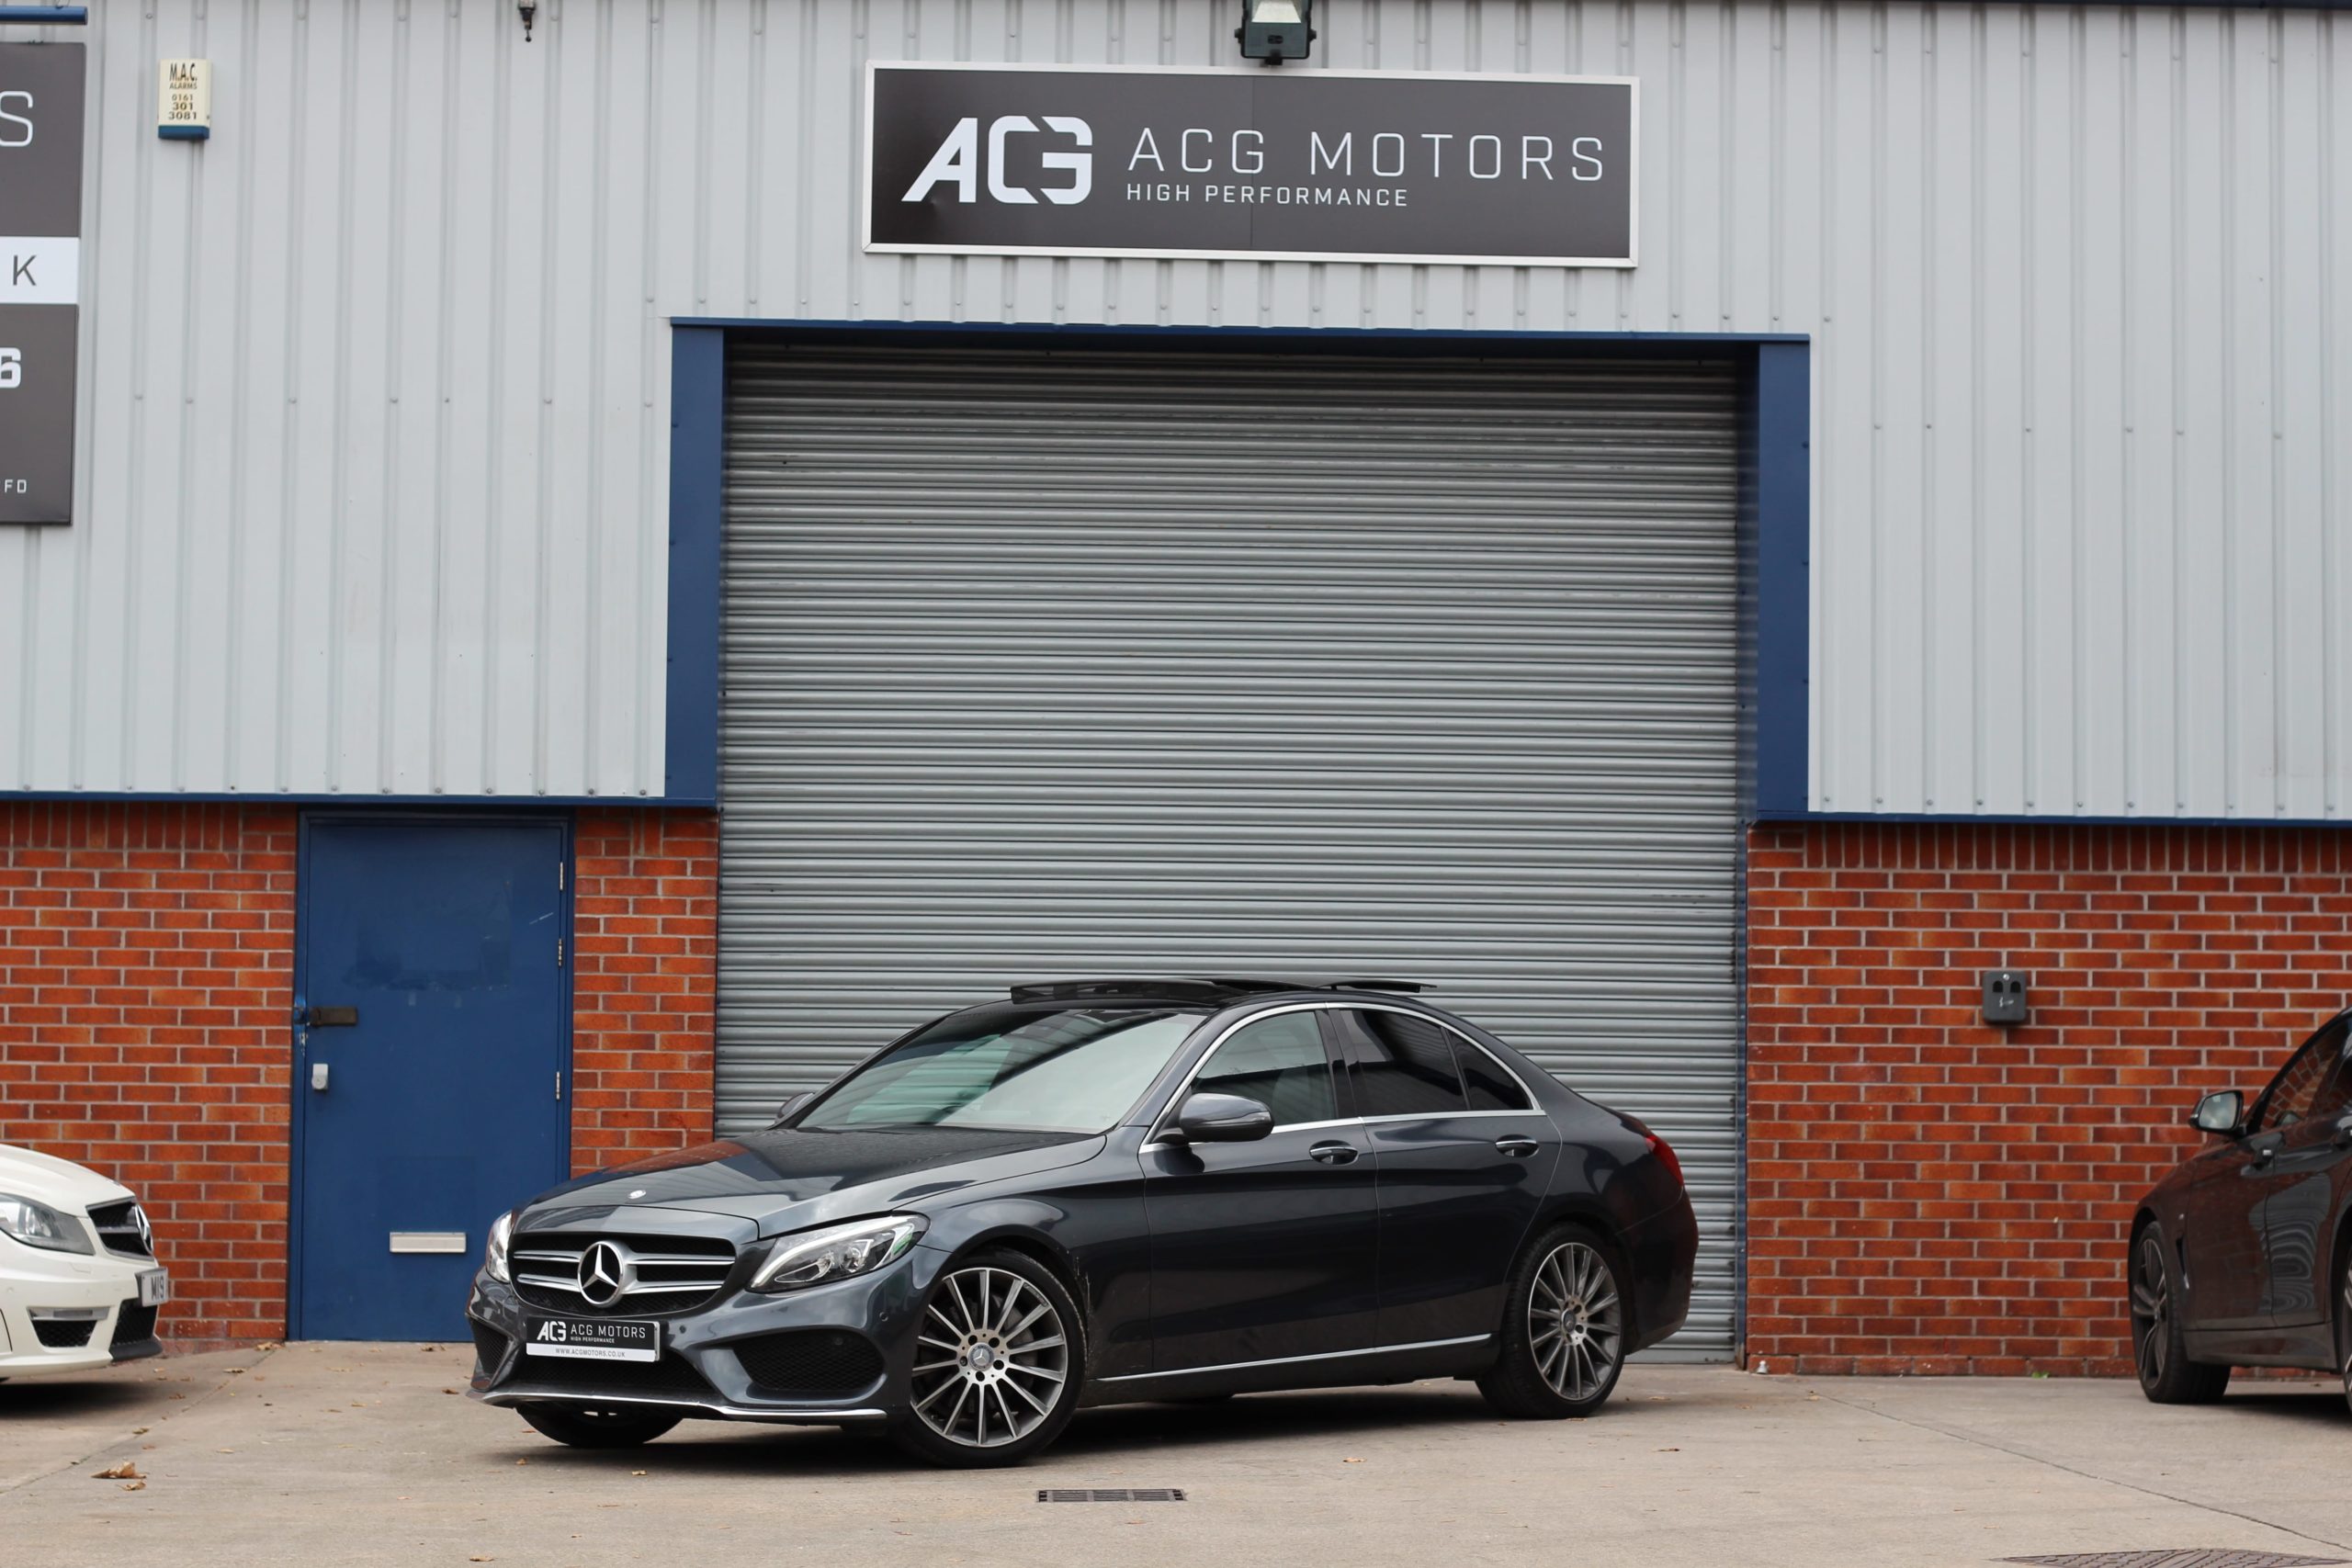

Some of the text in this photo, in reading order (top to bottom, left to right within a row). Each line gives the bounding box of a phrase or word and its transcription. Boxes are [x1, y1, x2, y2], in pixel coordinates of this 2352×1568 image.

[169, 62, 198, 81] M.A.C.
[169, 111, 197, 119] 3081
[173, 102, 193, 110] 301
[0, 91, 33, 147] S
[900, 115, 1093, 205] ACG
[1127, 127, 1603, 181] ACG MOTORS
[1126, 183, 1408, 207] HIGH PERFORMANCE
[13, 254, 37, 286] K
[0, 347, 21, 389] 6
[4, 479, 27, 493] FD
[537, 1321, 567, 1341] ACG
[571, 1324, 646, 1338] ACG MOTORS
[555, 1348, 626, 1358] WWW.ACGMOTORS.CO.UK
